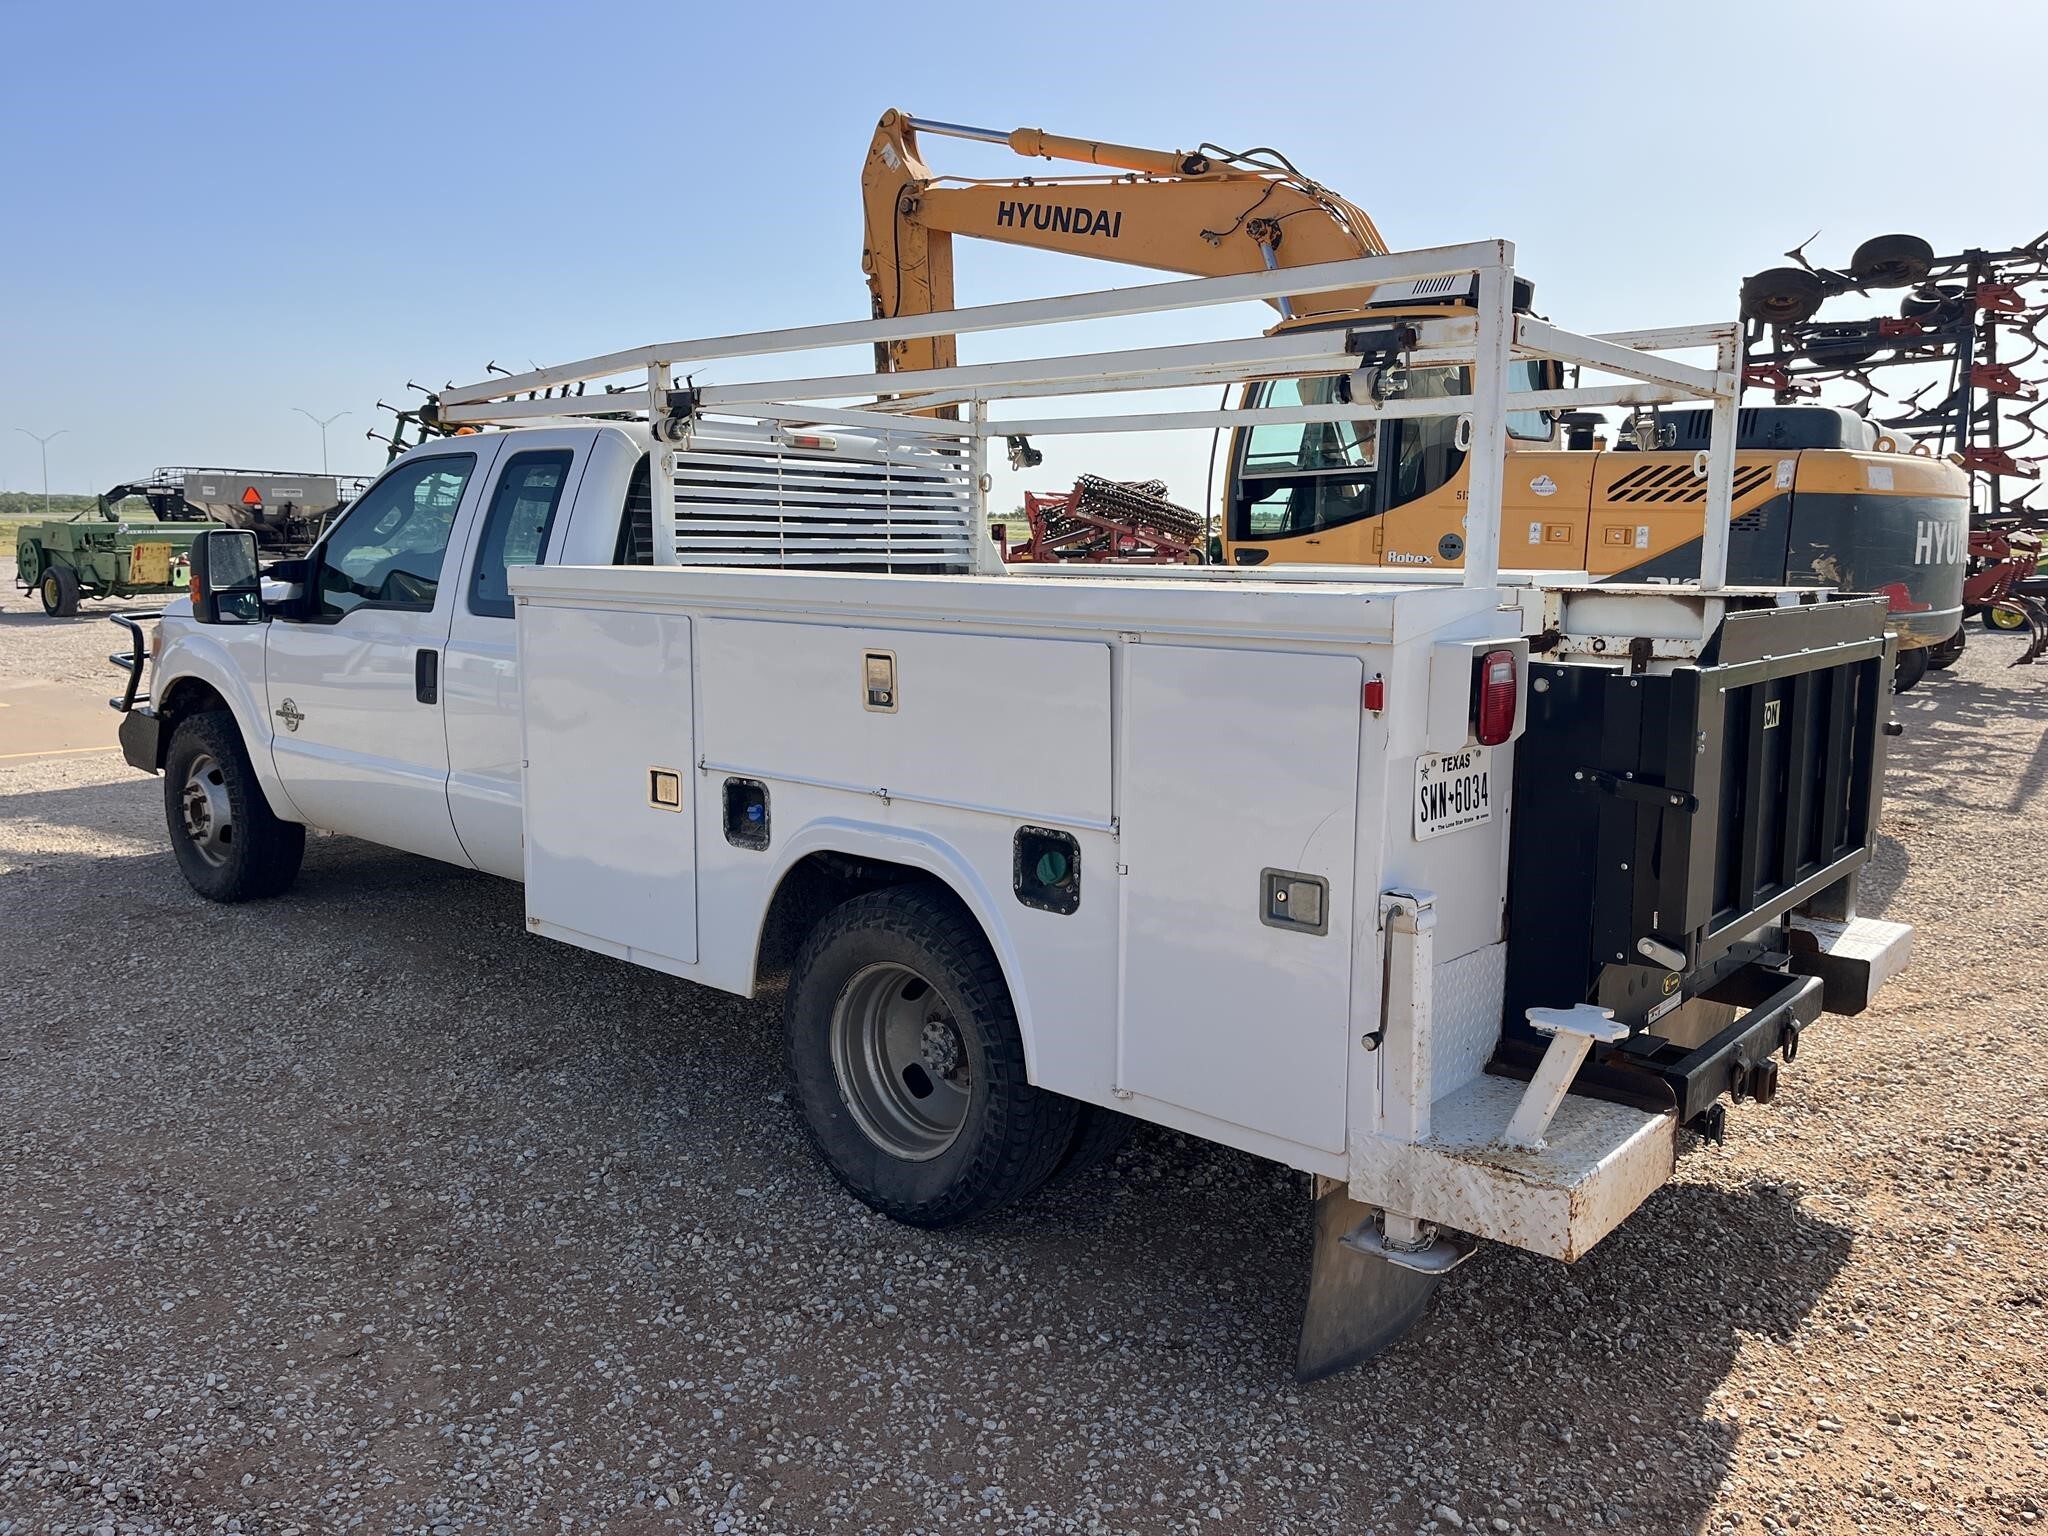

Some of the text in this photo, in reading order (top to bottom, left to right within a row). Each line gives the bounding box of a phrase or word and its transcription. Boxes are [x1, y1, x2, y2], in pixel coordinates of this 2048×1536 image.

[997, 200, 1122, 238] HYUNDAI
[1387, 550, 1434, 565] Robex
[1441, 753, 1471, 773] TEXAS
[1420, 772, 1488, 822] SWN 6034
